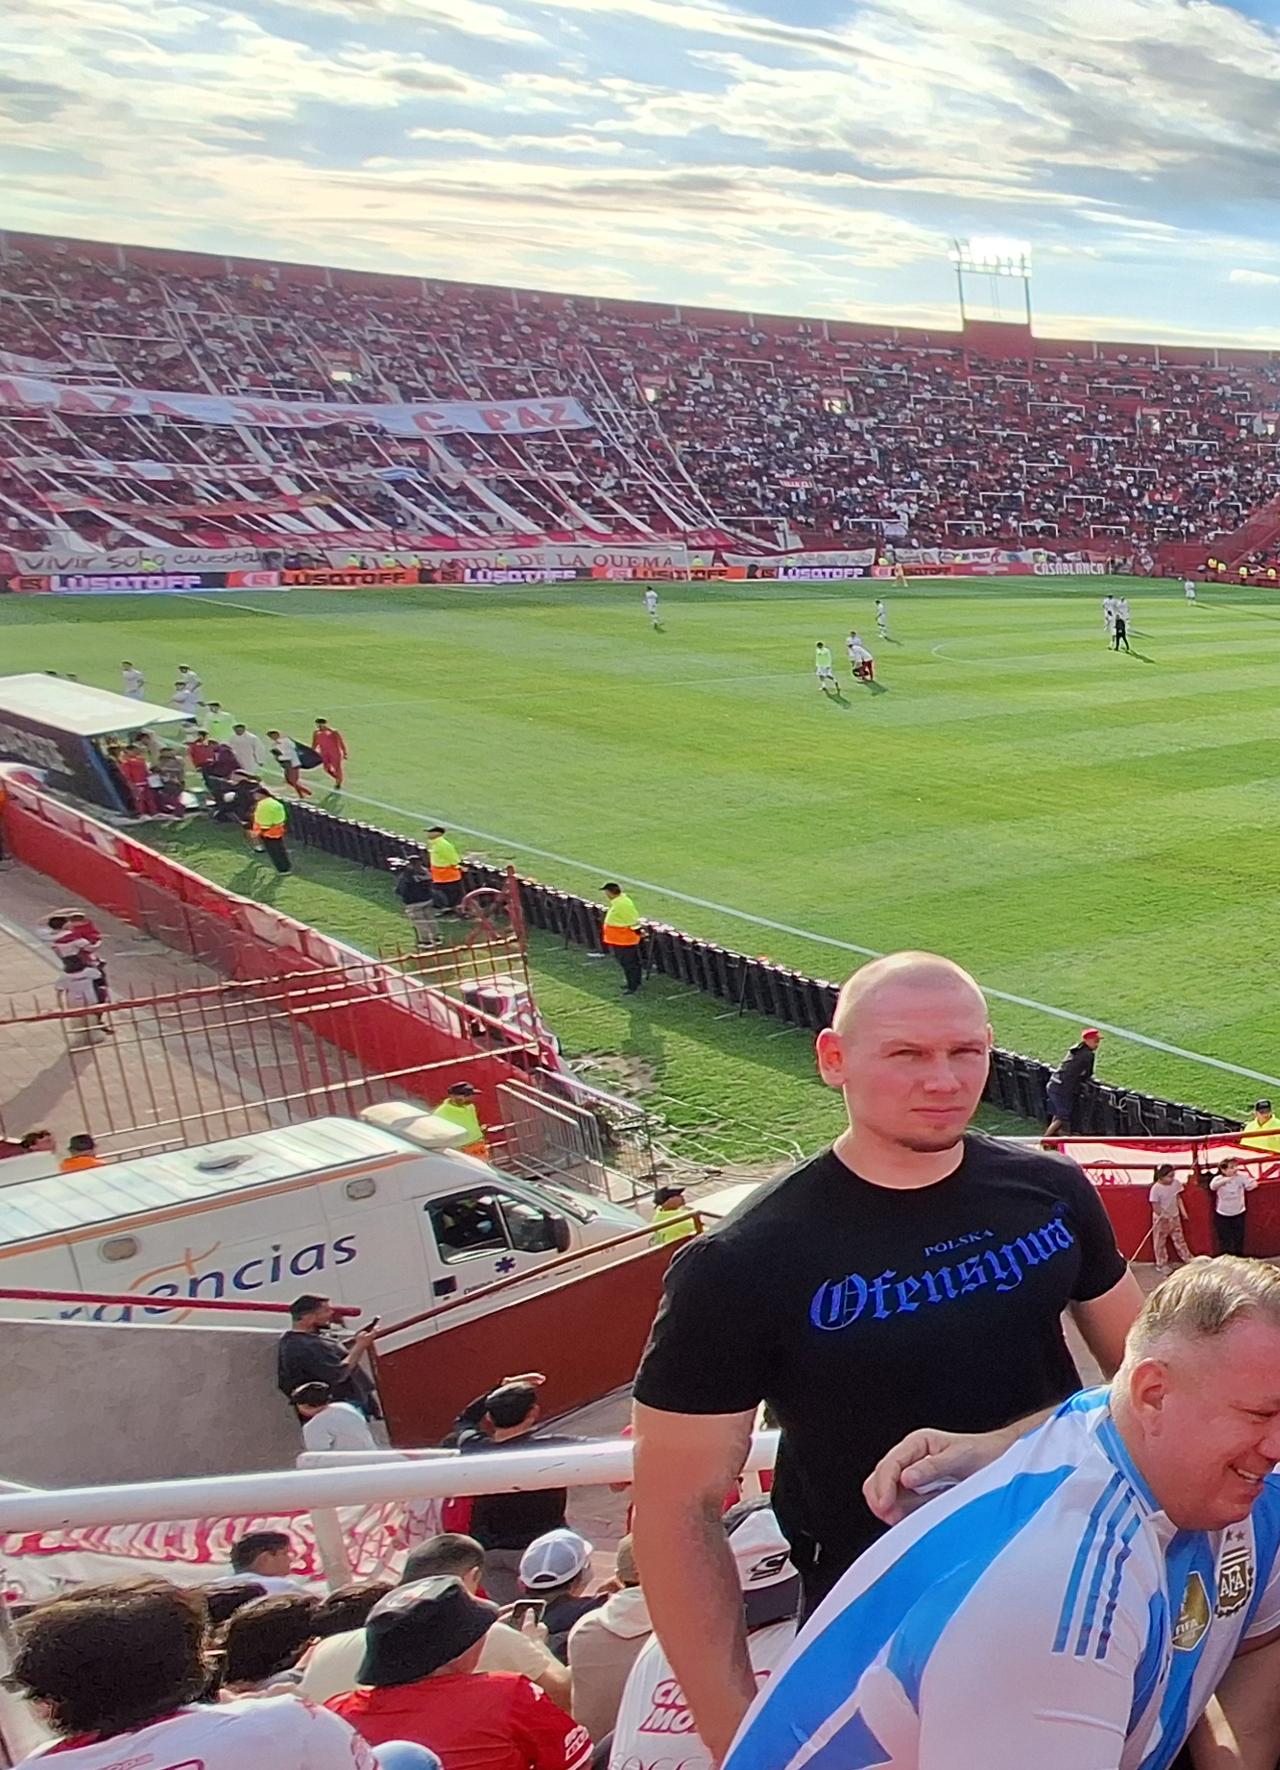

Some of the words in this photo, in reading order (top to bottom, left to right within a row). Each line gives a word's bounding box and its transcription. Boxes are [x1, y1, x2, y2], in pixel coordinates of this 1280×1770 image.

[480, 404, 580, 431] PAZ
[1034, 562, 1105, 576] CASABLANCA
[924, 1229, 995, 1257] POLSKA
[809, 1217, 1075, 1331] Ofensywa
[1220, 1565, 1245, 1598] AFA
[1175, 1618, 1199, 1636] FIFA
